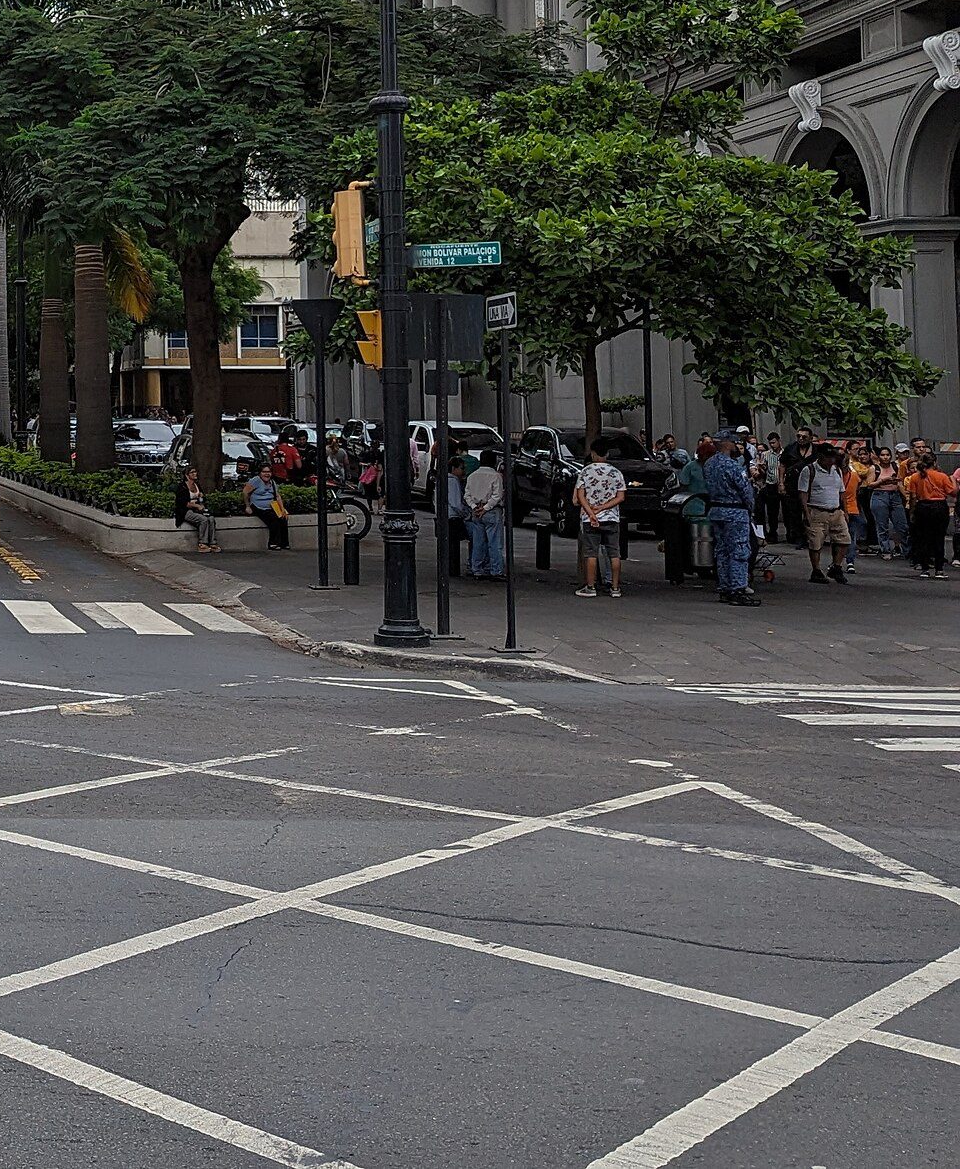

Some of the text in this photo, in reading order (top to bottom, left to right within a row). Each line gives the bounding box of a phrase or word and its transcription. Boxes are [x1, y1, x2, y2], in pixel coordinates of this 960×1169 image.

[433, 248, 462, 257] BOLIVAR
[463, 246, 497, 256] PALACIOS
[446, 257, 455, 265] 12
